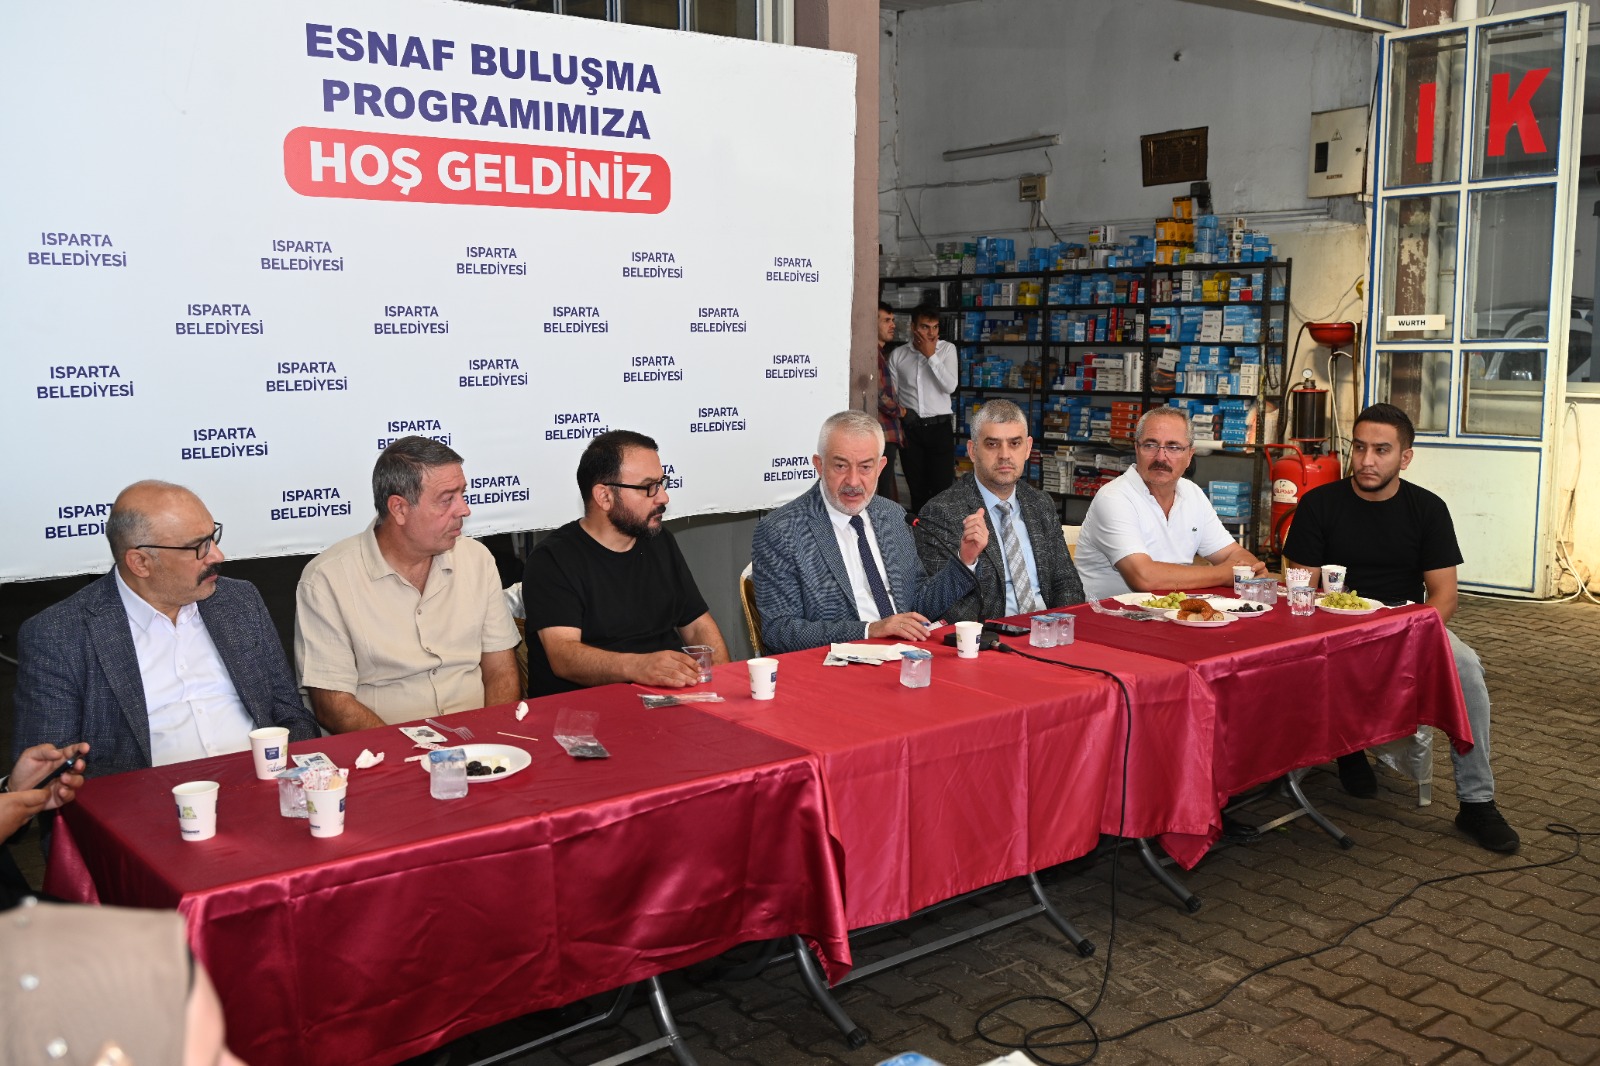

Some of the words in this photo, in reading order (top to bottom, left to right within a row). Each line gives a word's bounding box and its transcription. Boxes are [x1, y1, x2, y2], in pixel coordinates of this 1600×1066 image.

[306, 23, 454, 71] ESNAF
[471, 43, 661, 95] BULUŞMA
[323, 79, 650, 139] PROGRAMIMIZA
[309, 140, 422, 195] HOŞ
[437, 150, 653, 201] GELDİNİZ
[42, 232, 113, 247] ISPARTA
[273, 240, 332, 253] ISPARTA
[467, 247, 517, 258] ISPARTA
[28, 250, 127, 267] BELEDİYESİ
[261, 256, 343, 271] BELEDİYESİ
[632, 252, 675, 263] ISPARTA
[774, 257, 812, 268] ISPARTA
[457, 261, 526, 275] BELEDİYESİ
[623, 265, 682, 278] BELEDİYESİ
[766, 270, 819, 282] BELEDİYESİ
[188, 304, 251, 316] ISPARTA
[385, 306, 439, 317] ISPARTA
[553, 306, 600, 317] ISPARTA
[699, 308, 739, 317] ISPARTA
[176, 320, 263, 335] BELEDİYESİ
[374, 320, 448, 334] BELEDİYESİ
[544, 320, 608, 333] BELEDİYESİ
[690, 321, 746, 332] BELEDİYESİ
[469, 359, 519, 370] ISPARTA
[632, 356, 675, 367] ISPARTA
[773, 355, 810, 364] ISPARTA
[50, 365, 120, 379] ISPARTA
[278, 362, 336, 374] ISPARTA
[766, 366, 817, 378] BELEDİYESİ
[459, 372, 527, 387] BELEDİYESİ
[624, 369, 682, 382] BELEDİYESİ
[37, 381, 134, 399] BELEDİYESİ
[266, 376, 347, 392] BELEDİYESİ
[555, 413, 600, 424] ISPARTA
[699, 407, 739, 418] ISPARTA
[388, 420, 441, 432] ISPARTA
[690, 419, 746, 433] BELEDİYESİ
[194, 427, 256, 441] ISPARTA
[182, 441, 268, 460] BELEDİYESİ
[772, 456, 809, 467] ISPARTA
[763, 468, 816, 481] BELEDİYESİ
[470, 475, 521, 489] ISPARTA
[282, 488, 341, 502] ISPARTA
[463, 488, 530, 505] BELEDİYESİ
[271, 501, 351, 520] BELEDİYESİ
[45, 520, 105, 539] BELEDİ
